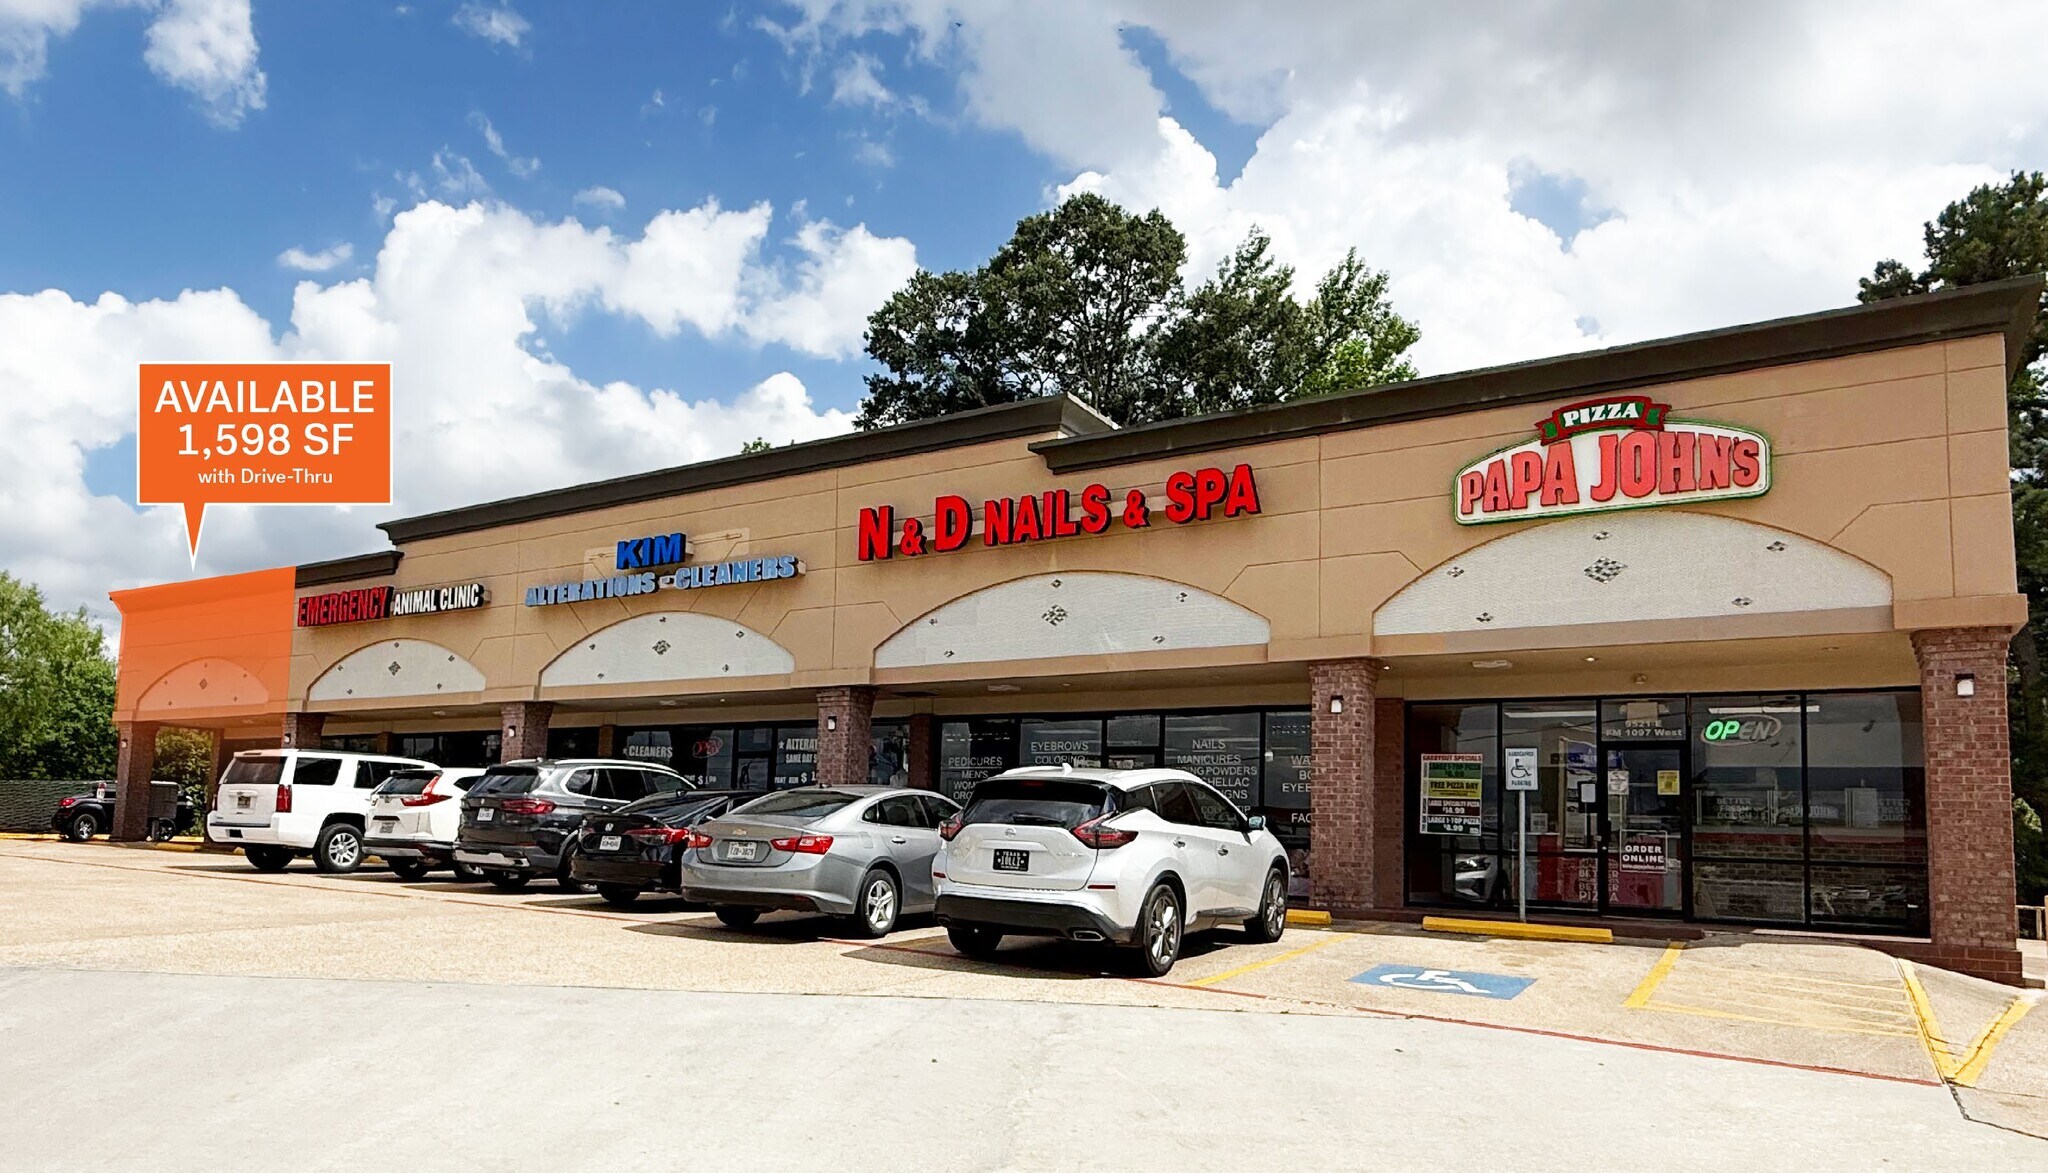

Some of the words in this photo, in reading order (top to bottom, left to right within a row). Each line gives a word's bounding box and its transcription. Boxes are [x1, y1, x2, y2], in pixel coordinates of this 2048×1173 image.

[1563, 402, 1639, 427] PIZZA
[1460, 440, 1579, 515] PAPA
[858, 505, 893, 561] N
[899, 517, 926, 556] &
[935, 495, 972, 552] D
[984, 484, 1111, 547] NAILS
[1123, 489, 1150, 528] &
[1165, 463, 1260, 524] SPA
[616, 532, 686, 570] KIM
[525, 571, 658, 607] ALTERATIONS
[674, 555, 799, 590] CLEANERS
[297, 586, 392, 628] EMERGENCY
[393, 589, 438, 616] ANIMAL
[439, 583, 483, 610] CLINIC
[1705, 720, 1771, 740] OPEN
[786, 738, 817, 750] ALTERAT
[1030, 741, 1089, 751] EYEBROWS
[1192, 739, 1226, 749] NAILS
[629, 745, 673, 758] CLEANERS
[786, 753, 801, 763] SAME
[948, 756, 1003, 766] PEDICURES
[1177, 755, 1242, 764] MANICURES
[961, 770, 988, 779] MEN'S
[1205, 766, 1257, 775] POWDERS
[953, 781, 976, 790] WOM
[1430, 781, 1446, 789] FREE
[1427, 816, 1446, 824] LARGE
[1624, 845, 1662, 854] ORDER
[1622, 854, 1665, 863] ONLINE
